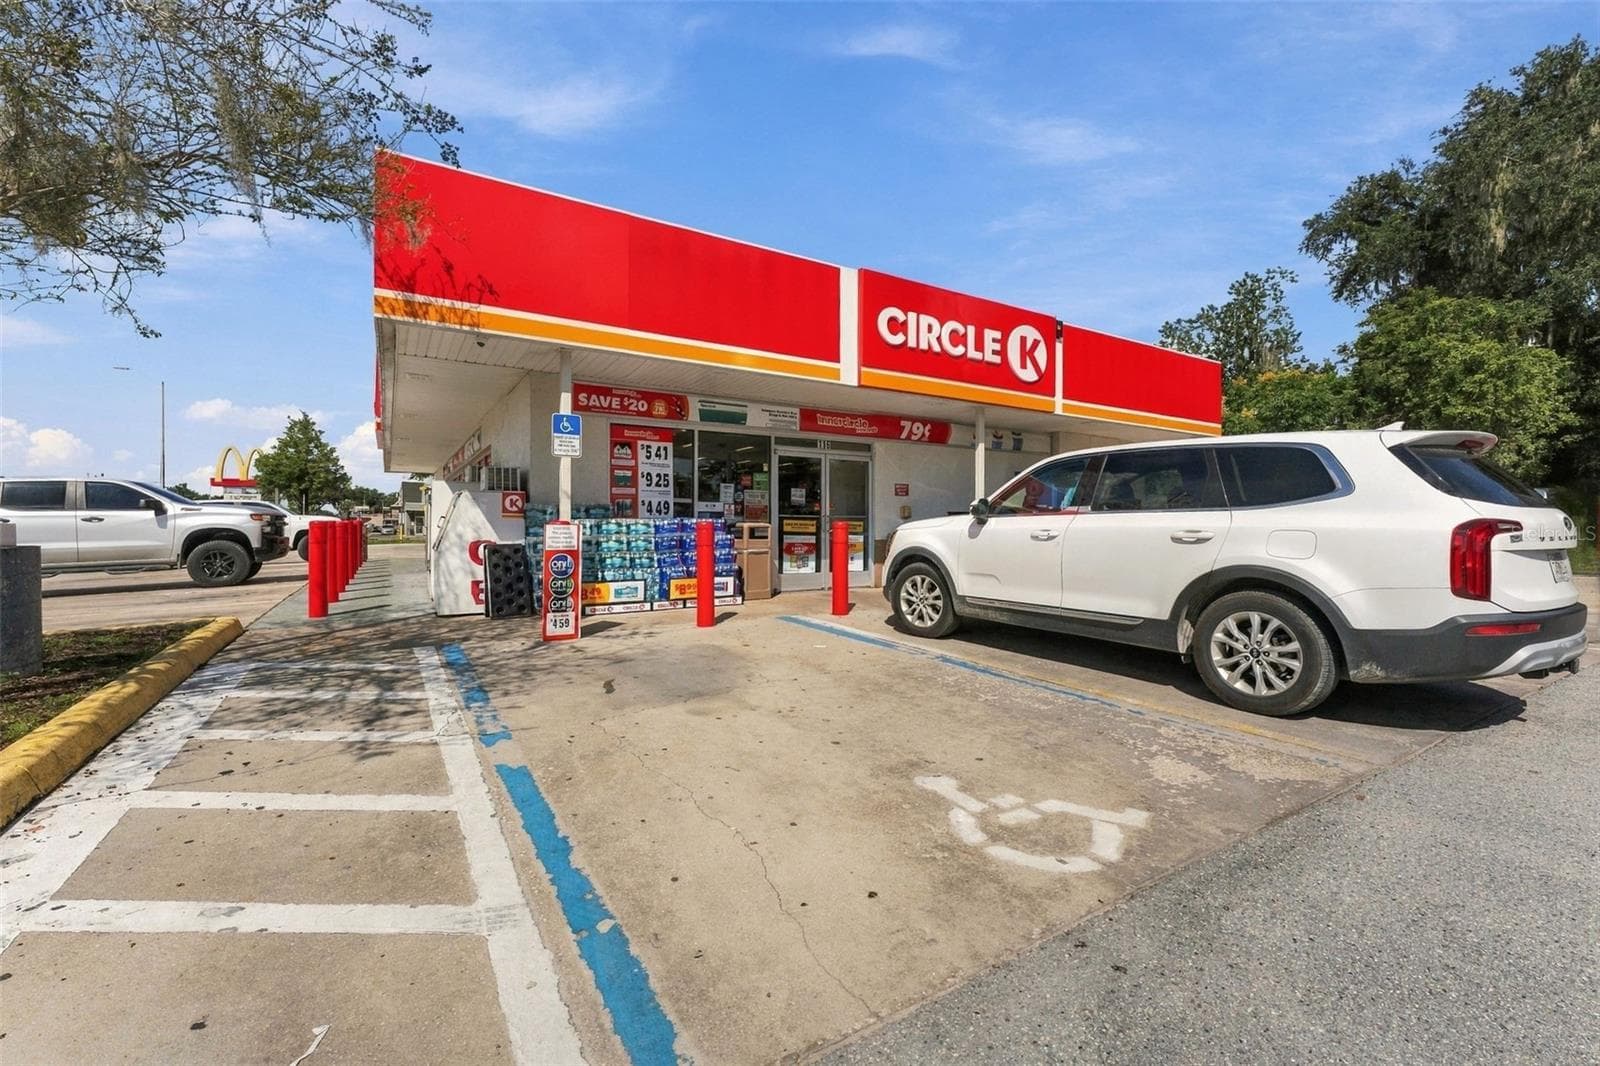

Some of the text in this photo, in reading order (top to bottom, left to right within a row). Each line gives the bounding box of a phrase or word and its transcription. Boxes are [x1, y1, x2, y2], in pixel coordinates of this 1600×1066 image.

[877, 306, 1044, 380] CIRCLE K
[578, 393, 621, 409] SAVE
[624, 397, 648, 412] $20
[900, 420, 931, 441] 79¢
[508, 497, 522, 511] K
